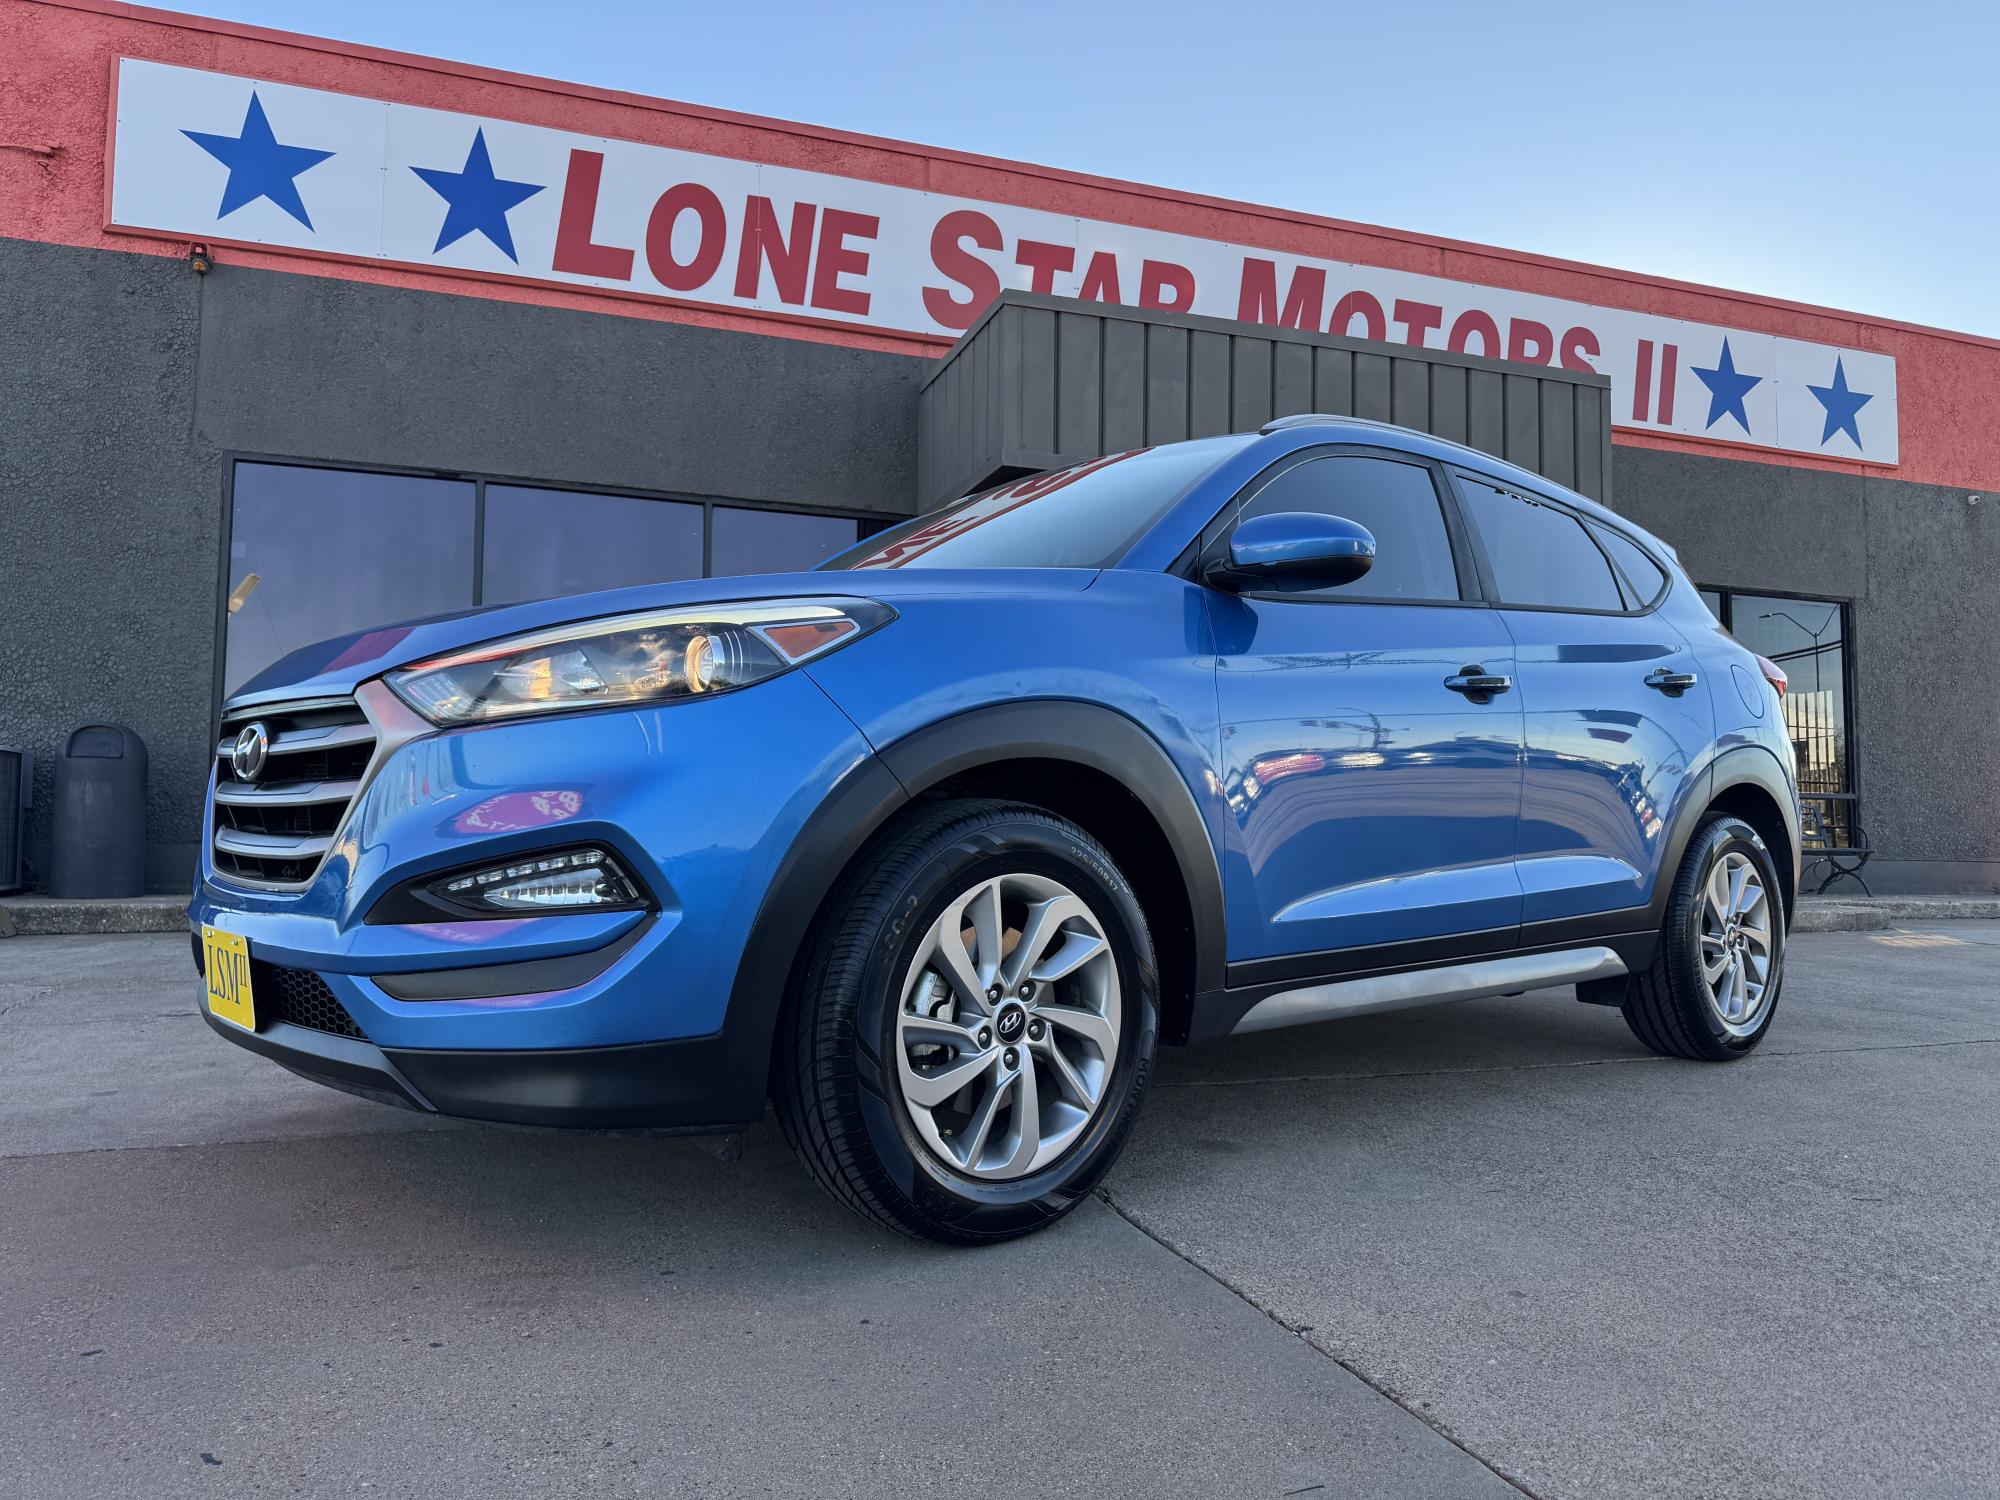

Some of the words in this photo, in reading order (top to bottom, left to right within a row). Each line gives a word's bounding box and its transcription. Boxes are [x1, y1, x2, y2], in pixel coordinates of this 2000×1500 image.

[552, 148, 880, 316] LONE
[1237, 257, 1601, 374] MOTORS
[1633, 339, 1678, 426] II
